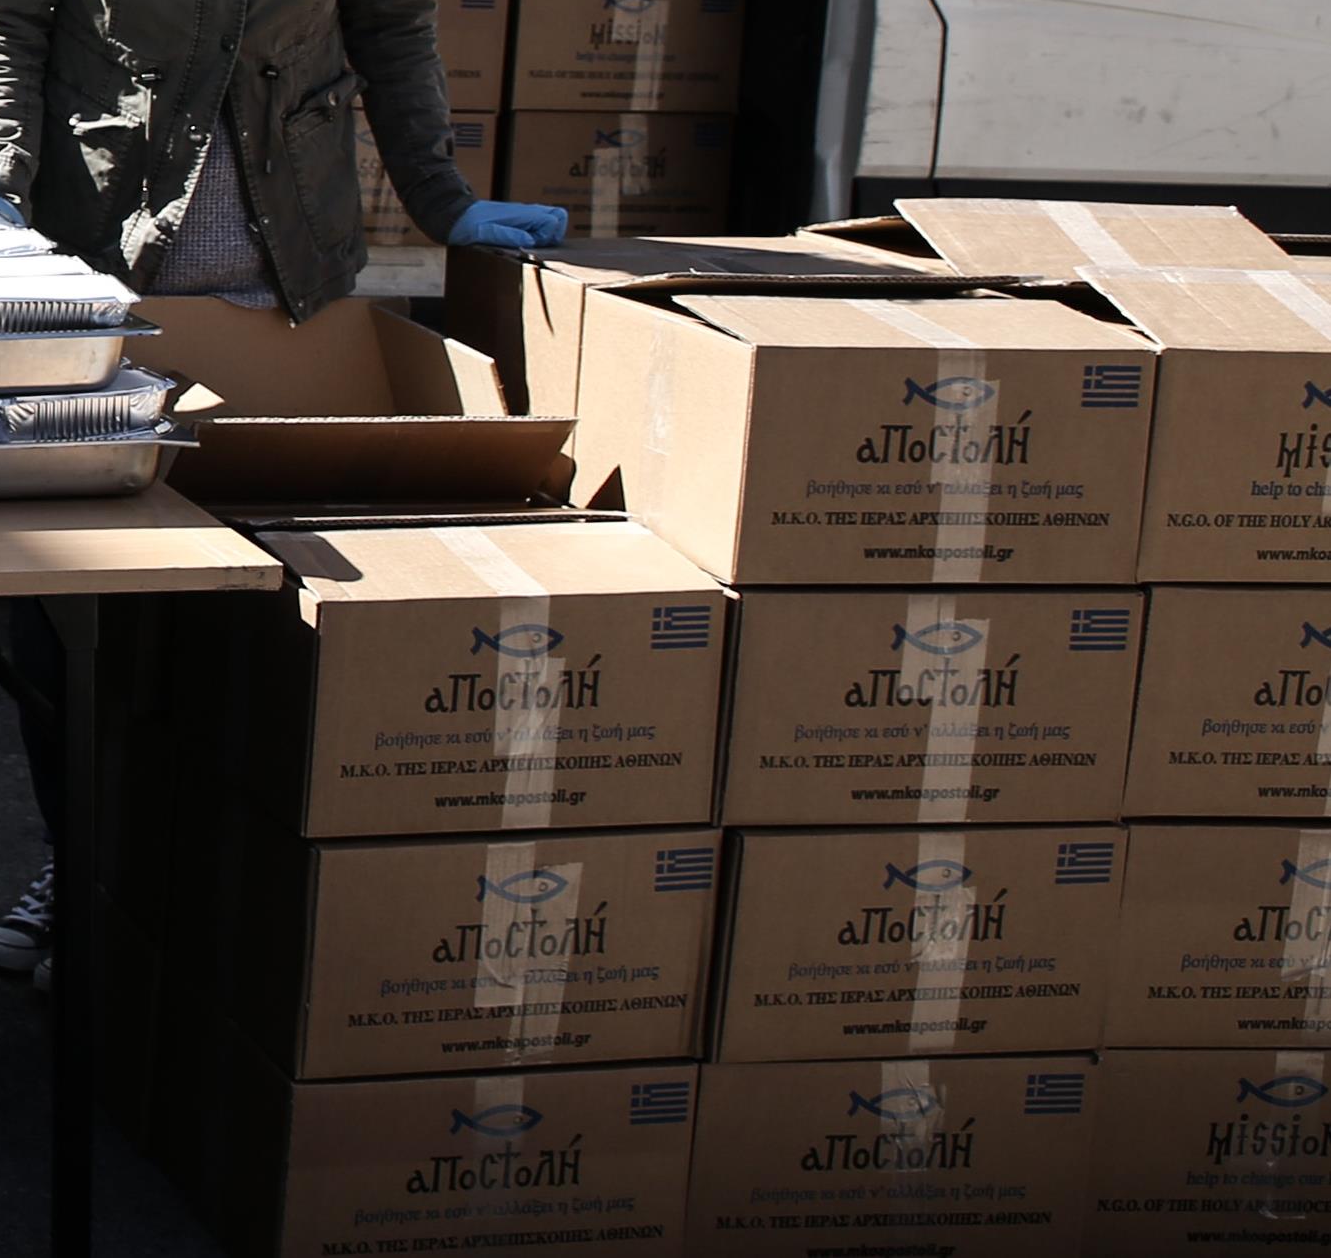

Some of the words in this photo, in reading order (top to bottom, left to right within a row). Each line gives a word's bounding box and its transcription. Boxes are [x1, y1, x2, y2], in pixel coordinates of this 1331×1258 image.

[1055, 484, 1084, 499] μας
[1250, 481, 1283, 499] help
[1287, 482, 1302, 497] to
[825, 511, 857, 526] ΤΗΣ
[860, 511, 906, 526] ΙΕΡΑΣ
[1042, 513, 1111, 527] ΑΘΗΝΩΝ
[1214, 513, 1234, 528] OF
[1238, 513, 1269, 528] THE
[1271, 514, 1312, 529] HOLY
[864, 544, 1015, 562] www.mkoapostoli.gr
[627, 725, 656, 740] μας
[1042, 726, 1071, 741] μας
[395, 762, 427, 776] ΤΗΣ
[431, 759, 477, 775] ΙΕΡΑΣ
[614, 752, 683, 768] ΑΘΗΝΩΝ
[813, 754, 846, 768] ΤΗΣ
[848, 754, 893, 768] ΙΕΡΑΣ
[1028, 752, 1097, 767] ΑΘΗΝΩΝ
[1220, 752, 1252, 765] ΤΗΣ
[1255, 752, 1300, 765] ΙΕΡΑΣ
[851, 785, 1000, 802] www.mkoapostoli.gr
[1028, 957, 1056, 972] μας
[631, 966, 660, 982] μας
[806, 991, 837, 1005] ΤΗΣ
[840, 990, 885, 1003] ΙΕΡΑΣ
[1015, 983, 1080, 999] ΑΘΗΝΩΝ
[1200, 986, 1232, 999] ΤΗΣ
[1235, 986, 1281, 999] ΙΕΡΑΣ
[401, 1010, 434, 1024] ΤΗΣ
[438, 1007, 484, 1022] ΙΕΡΑΣ
[620, 994, 688, 1011] ΑΘΗΝΩΝ
[1143, 1198, 1165, 1212] OF
[1167, 1198, 1196, 1212] THE
[1200, 1199, 1241, 1212] HOLY
